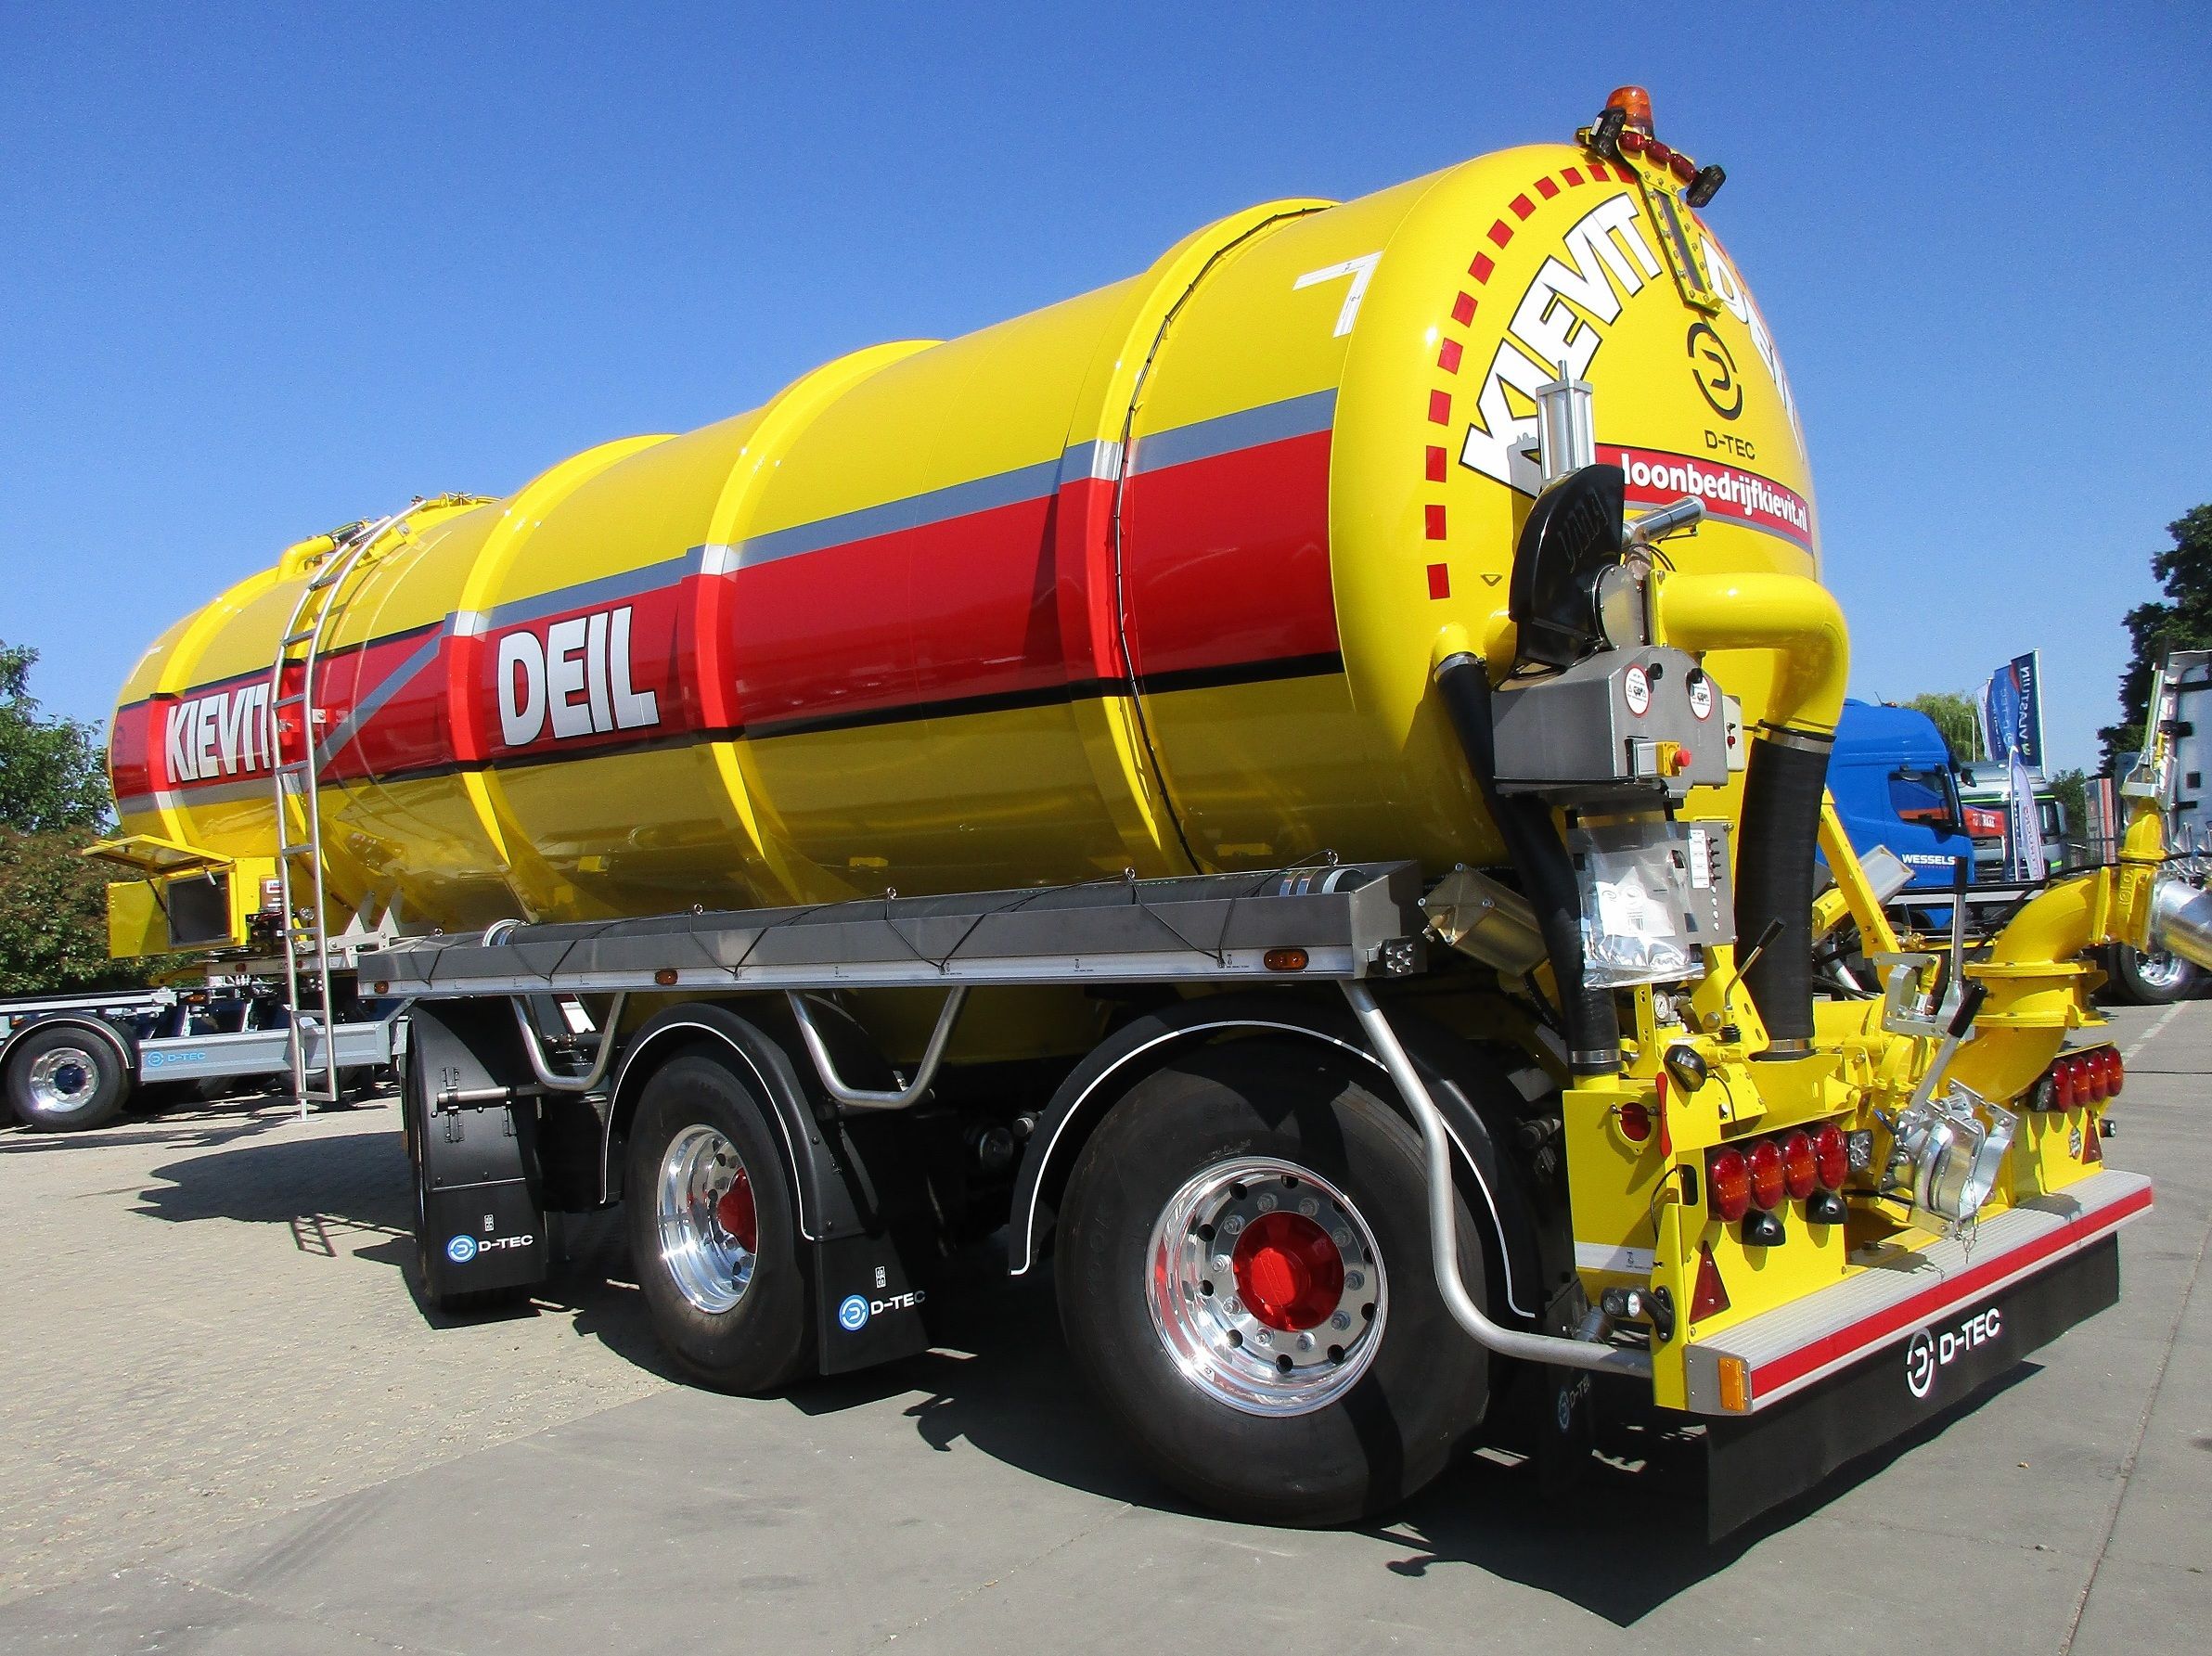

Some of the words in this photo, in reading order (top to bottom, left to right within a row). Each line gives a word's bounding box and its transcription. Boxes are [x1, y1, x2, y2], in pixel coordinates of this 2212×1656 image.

[1459, 192, 1664, 500] KIEVIT
[1704, 430, 1755, 460] D-TEC
[1621, 453, 1808, 533] loonbedrijfkievit.nl
[497, 606, 660, 746] DEIL
[165, 682, 271, 783] KIEVIT
[1901, 854, 1955, 866] WESSELS
[167, 1052, 206, 1062] D-TEC
[478, 1234, 534, 1252] D-TEC
[870, 1290, 926, 1316] D-TEC
[1939, 1307, 2000, 1366] D-TEC
